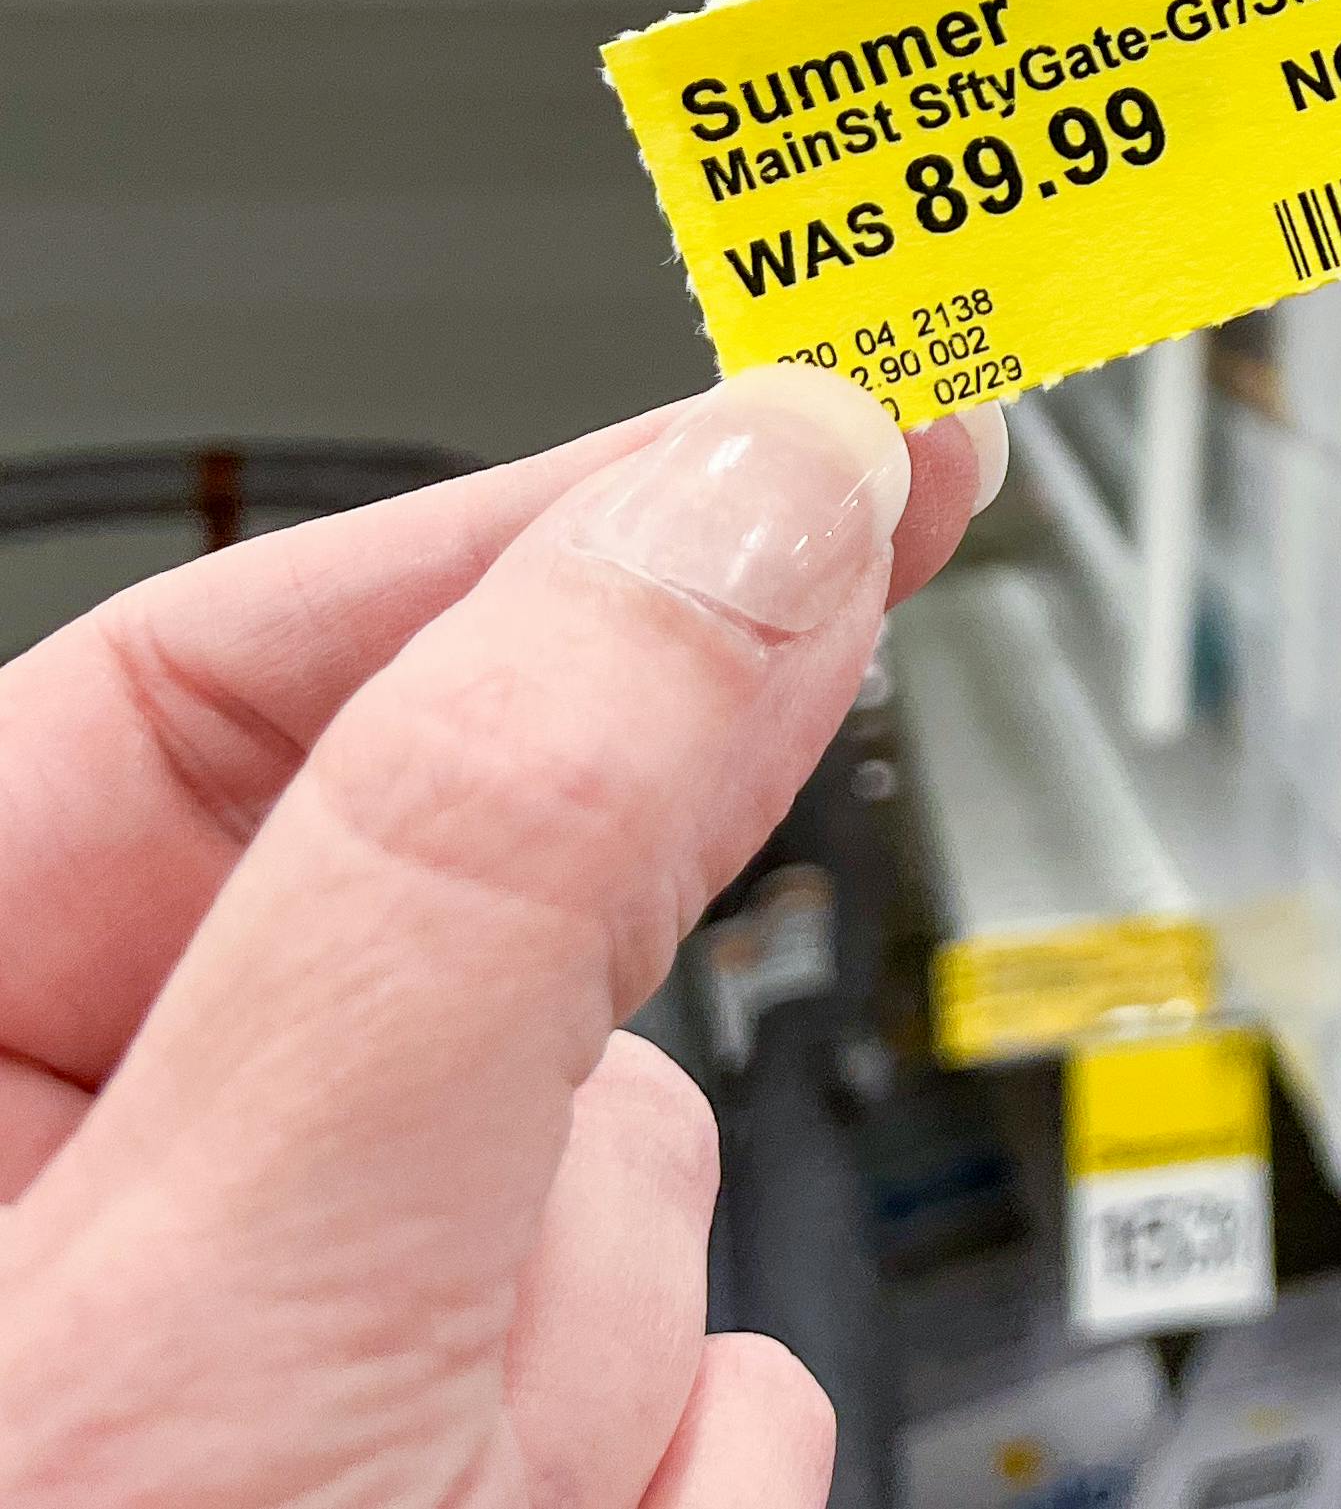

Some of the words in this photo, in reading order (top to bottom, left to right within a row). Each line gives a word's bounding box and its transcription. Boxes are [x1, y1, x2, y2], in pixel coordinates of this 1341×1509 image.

[701, 102, 901, 202] MainSt
[725, 203, 894, 298] WAS
[906, 88, 1166, 234] 89.99
[855, 320, 895, 356] 04
[912, 288, 994, 337] 2138
[929, 325, 990, 366] 002
[934, 354, 1023, 406] 02/29
